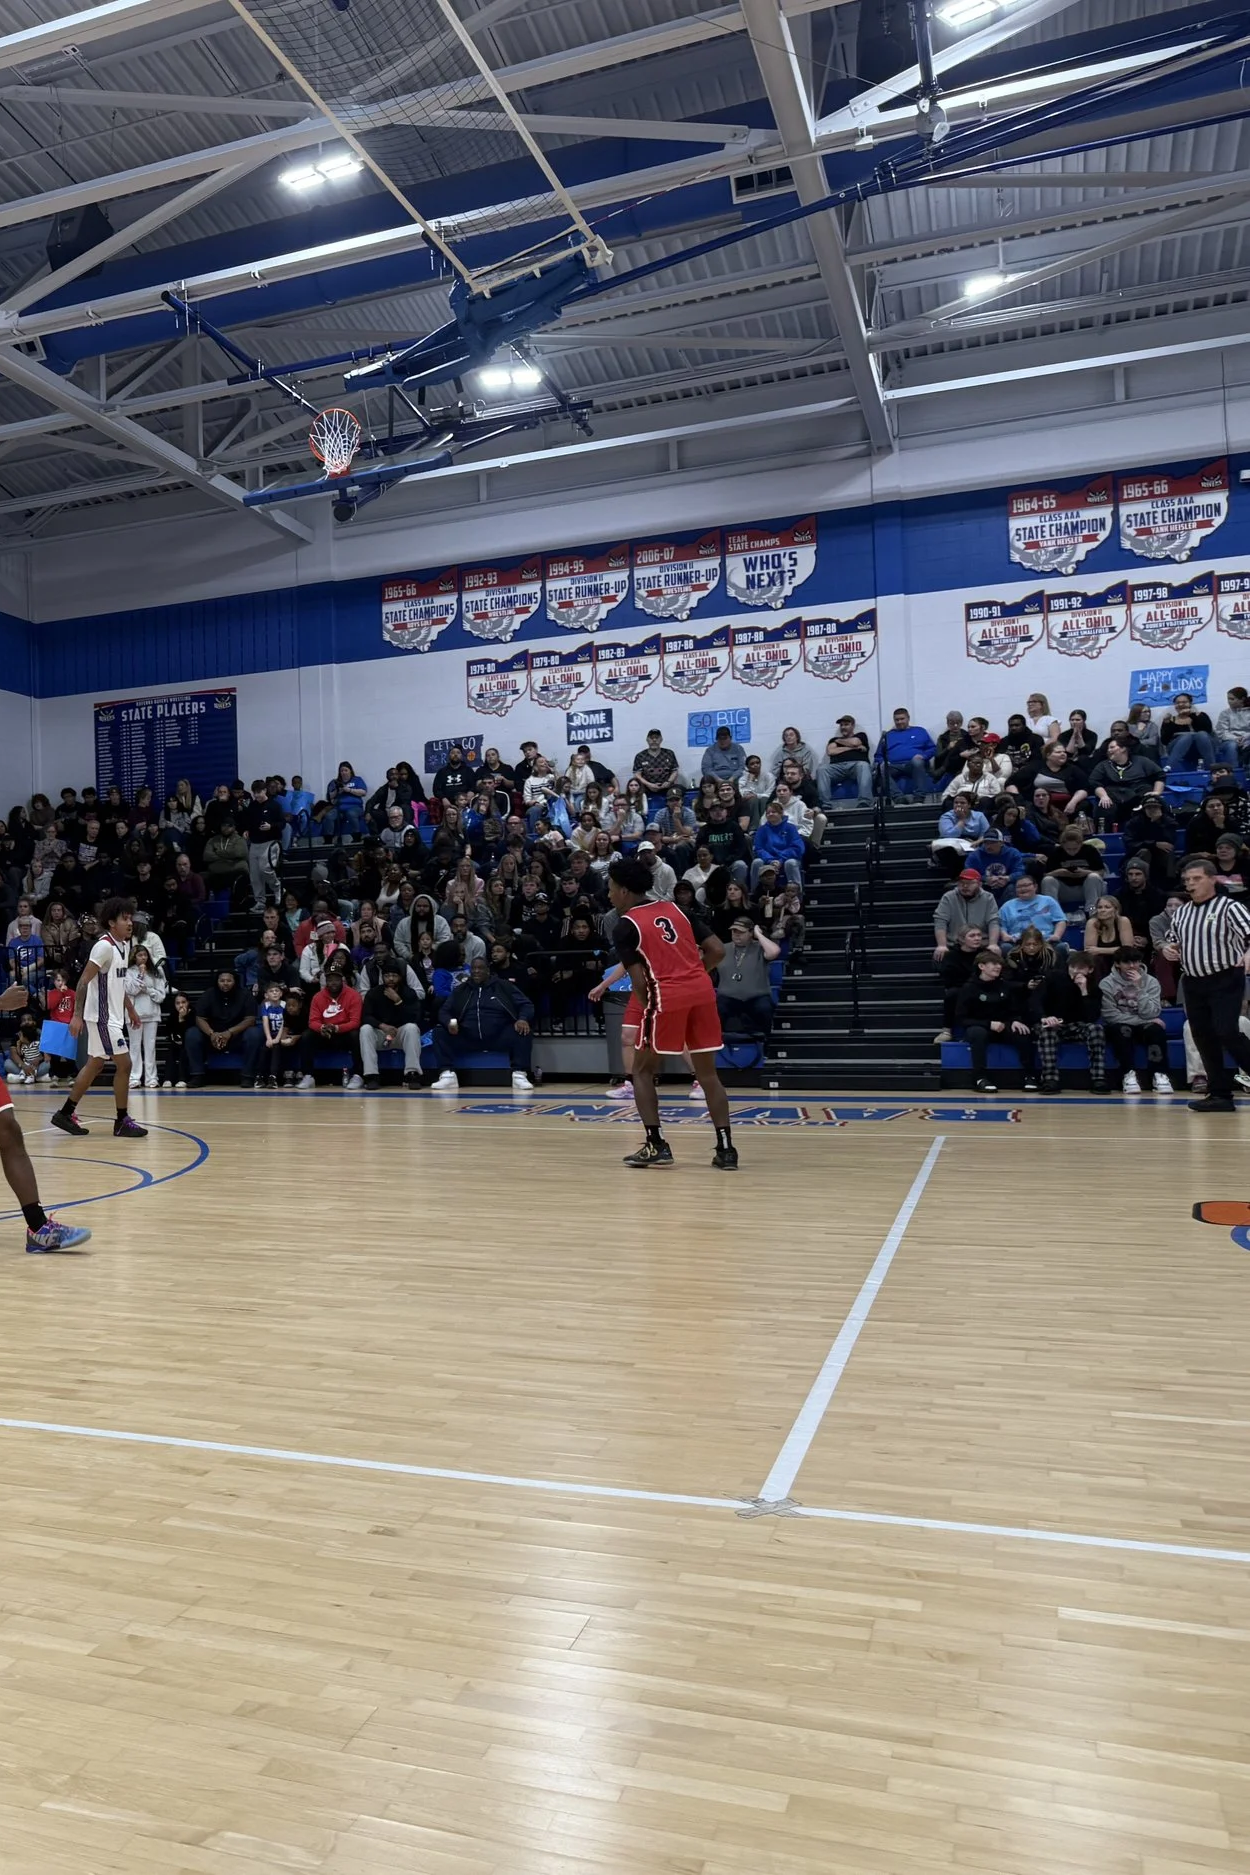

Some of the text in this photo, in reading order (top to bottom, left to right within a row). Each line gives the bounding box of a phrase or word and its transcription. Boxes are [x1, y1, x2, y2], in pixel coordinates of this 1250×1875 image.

[1122, 480, 1168, 499] 1965-66
[1012, 494, 1056, 513] 1964-65
[1126, 503, 1221, 528] STATE CHAMPION
[1016, 518, 1106, 542] STATE CHAMPION
[728, 535, 748, 544] TEAM
[728, 538, 780, 551] STATE CHAMPS
[637, 548, 674, 564] 2006-07
[744, 552, 798, 572] WHO'S
[549, 562, 584, 576] 1994-95
[464, 572, 498, 588] 1992-93
[636, 568, 718, 590] STATE RUNNER-UP
[745, 570, 796, 590] NEXT?
[548, 580, 626, 602] STATE RUNNER-UP
[1134, 587, 1168, 602] 1997-98
[465, 592, 538, 614] STATE CHAMPIONS
[1050, 597, 1082, 610] 1991-92
[385, 603, 454, 624] STATE CHAMPIONS
[970, 607, 1000, 620] 1990-91
[1146, 606, 1198, 622] ALL-OHIO
[807, 623, 836, 636] 1987-88
[1062, 616, 1112, 631] ALL-OHIO
[735, 631, 764, 644] 1987-88
[982, 624, 1030, 640] ALL-OHIO
[666, 640, 694, 651] 1987-88
[818, 641, 862, 655] ALL-OHIO
[676, 657, 718, 670] ALL-OHIO
[746, 649, 788, 663] ALL-OHIO
[542, 672, 582, 685] ALL-OHIO
[608, 664, 648, 678] ALL-OHIO
[1140, 670, 1174, 684] HAPPY
[479, 680, 518, 692] ALL-OHIO
[122, 702, 206, 722] STATE PLACERS
[573, 712, 606, 727] HOME
[690, 709, 748, 728] GO BIG
[570, 727, 612, 742] ADULTS
[462, 736, 476, 750] GO
[654, 916, 678, 944] 3
[271, 1020, 282, 1031] 15
